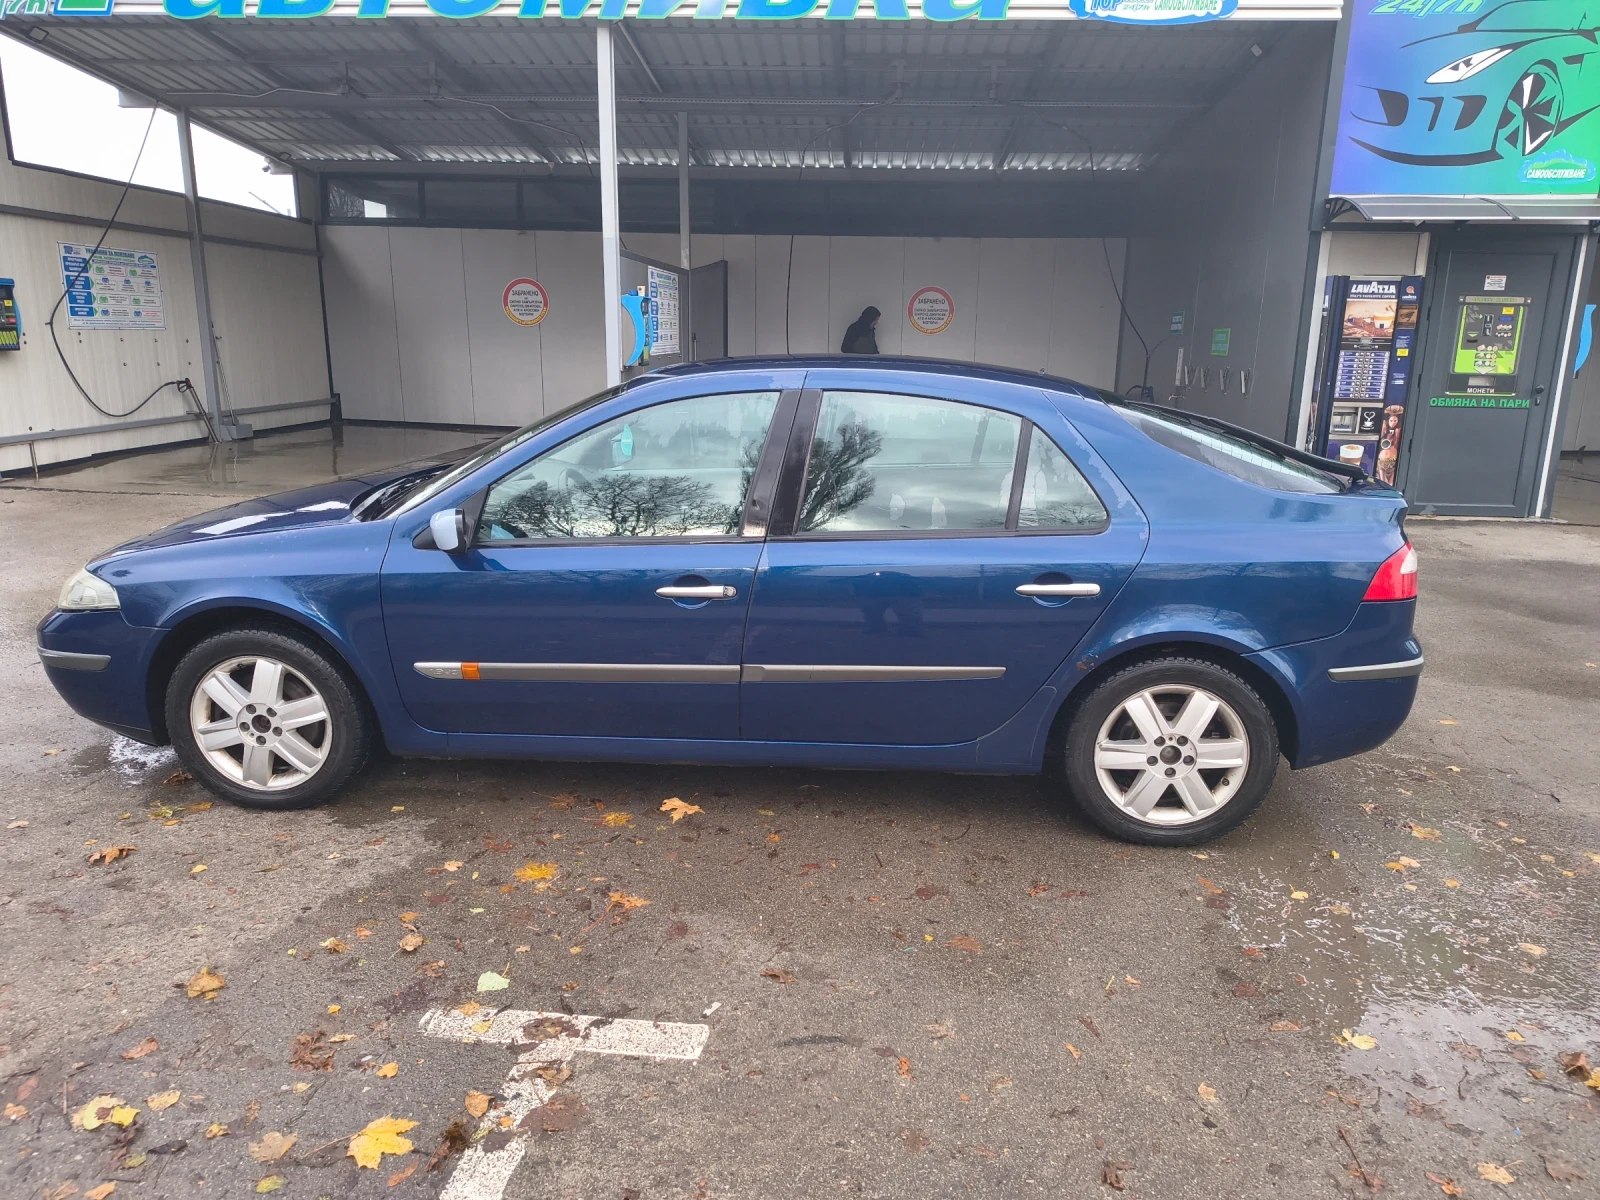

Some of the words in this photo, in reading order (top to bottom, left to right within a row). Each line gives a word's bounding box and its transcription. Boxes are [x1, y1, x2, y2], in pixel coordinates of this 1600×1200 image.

[1350, 281, 1397, 294] LAVAZZA
[1429, 397, 1478, 407] ОБМЯНА
[1480, 398, 1496, 407] НА
[1499, 399, 1531, 408] ПАРИ
